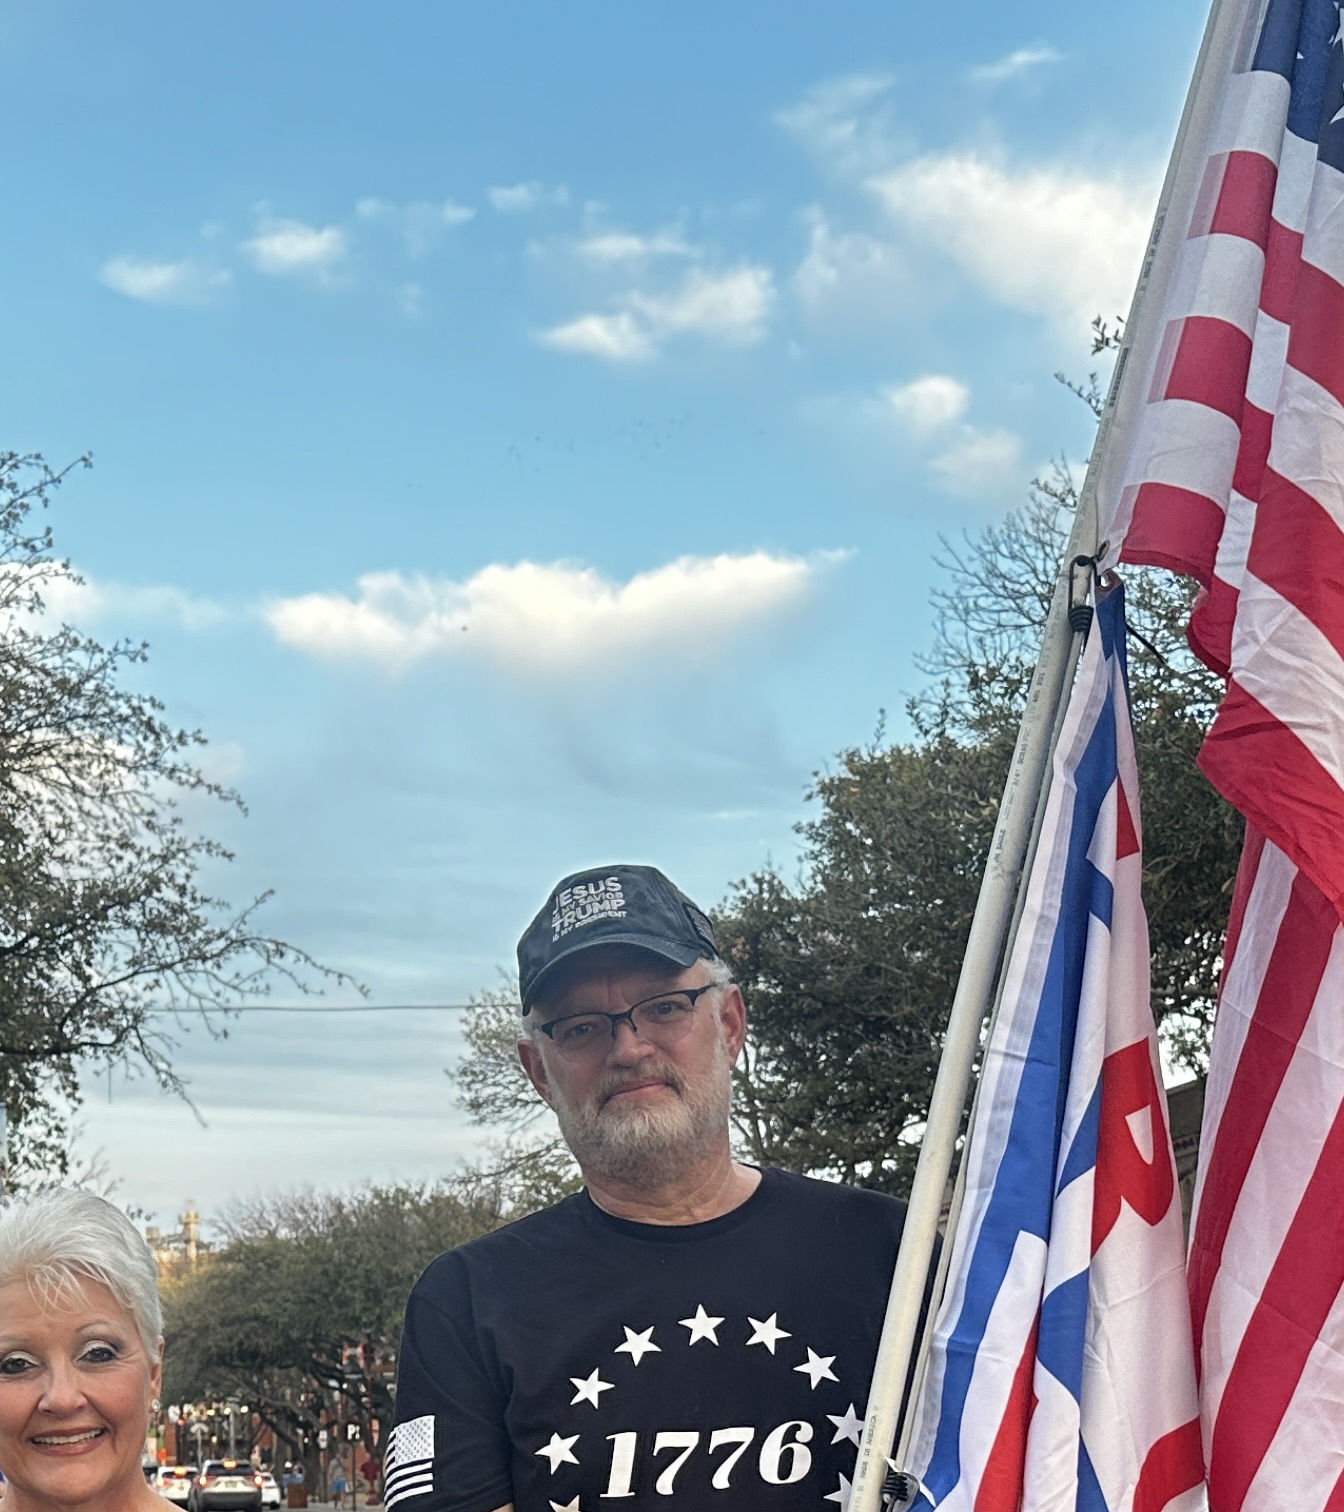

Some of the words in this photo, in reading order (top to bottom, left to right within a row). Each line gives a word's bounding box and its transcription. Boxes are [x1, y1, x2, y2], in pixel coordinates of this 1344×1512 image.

[552, 877, 622, 915] JESUS
[561, 901, 575, 916] MY
[578, 892, 624, 906] SAVIOR
[551, 899, 625, 932] TRUMP
[600, 1421, 814, 1498] 1776
